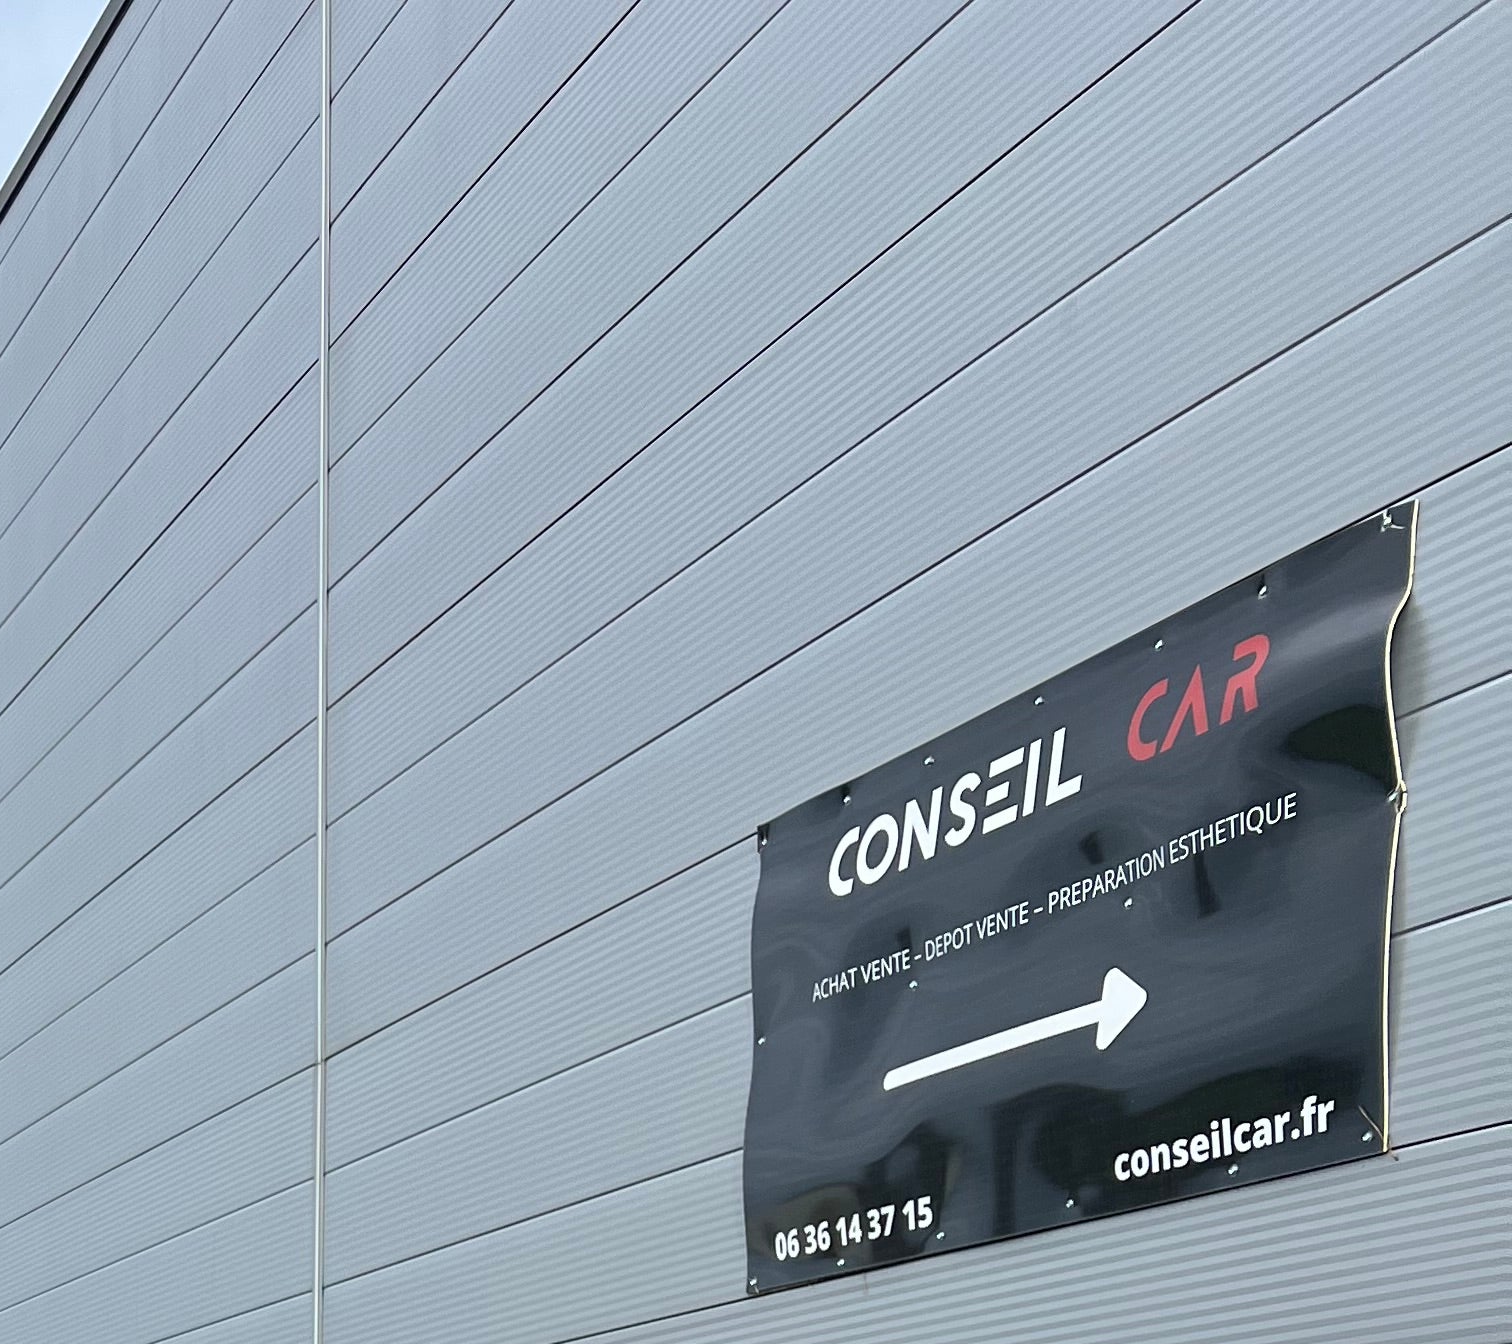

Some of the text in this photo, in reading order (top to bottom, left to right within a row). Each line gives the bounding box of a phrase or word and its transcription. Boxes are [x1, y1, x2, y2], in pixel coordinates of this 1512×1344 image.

[829, 634, 1270, 896] CONSEIL CAR
[812, 967, 857, 1002] ACHAT
[860, 949, 910, 983] VENTE
[925, 923, 973, 961] DEPOT
[976, 901, 1029, 939] VENTE
[1048, 846, 1165, 914] PREPARATION
[1169, 792, 1297, 864] ESTHETIQUE
[1114, 1095, 1335, 1181] conseilcar.fr
[775, 1196, 933, 1261] 06 36 14 37 15
